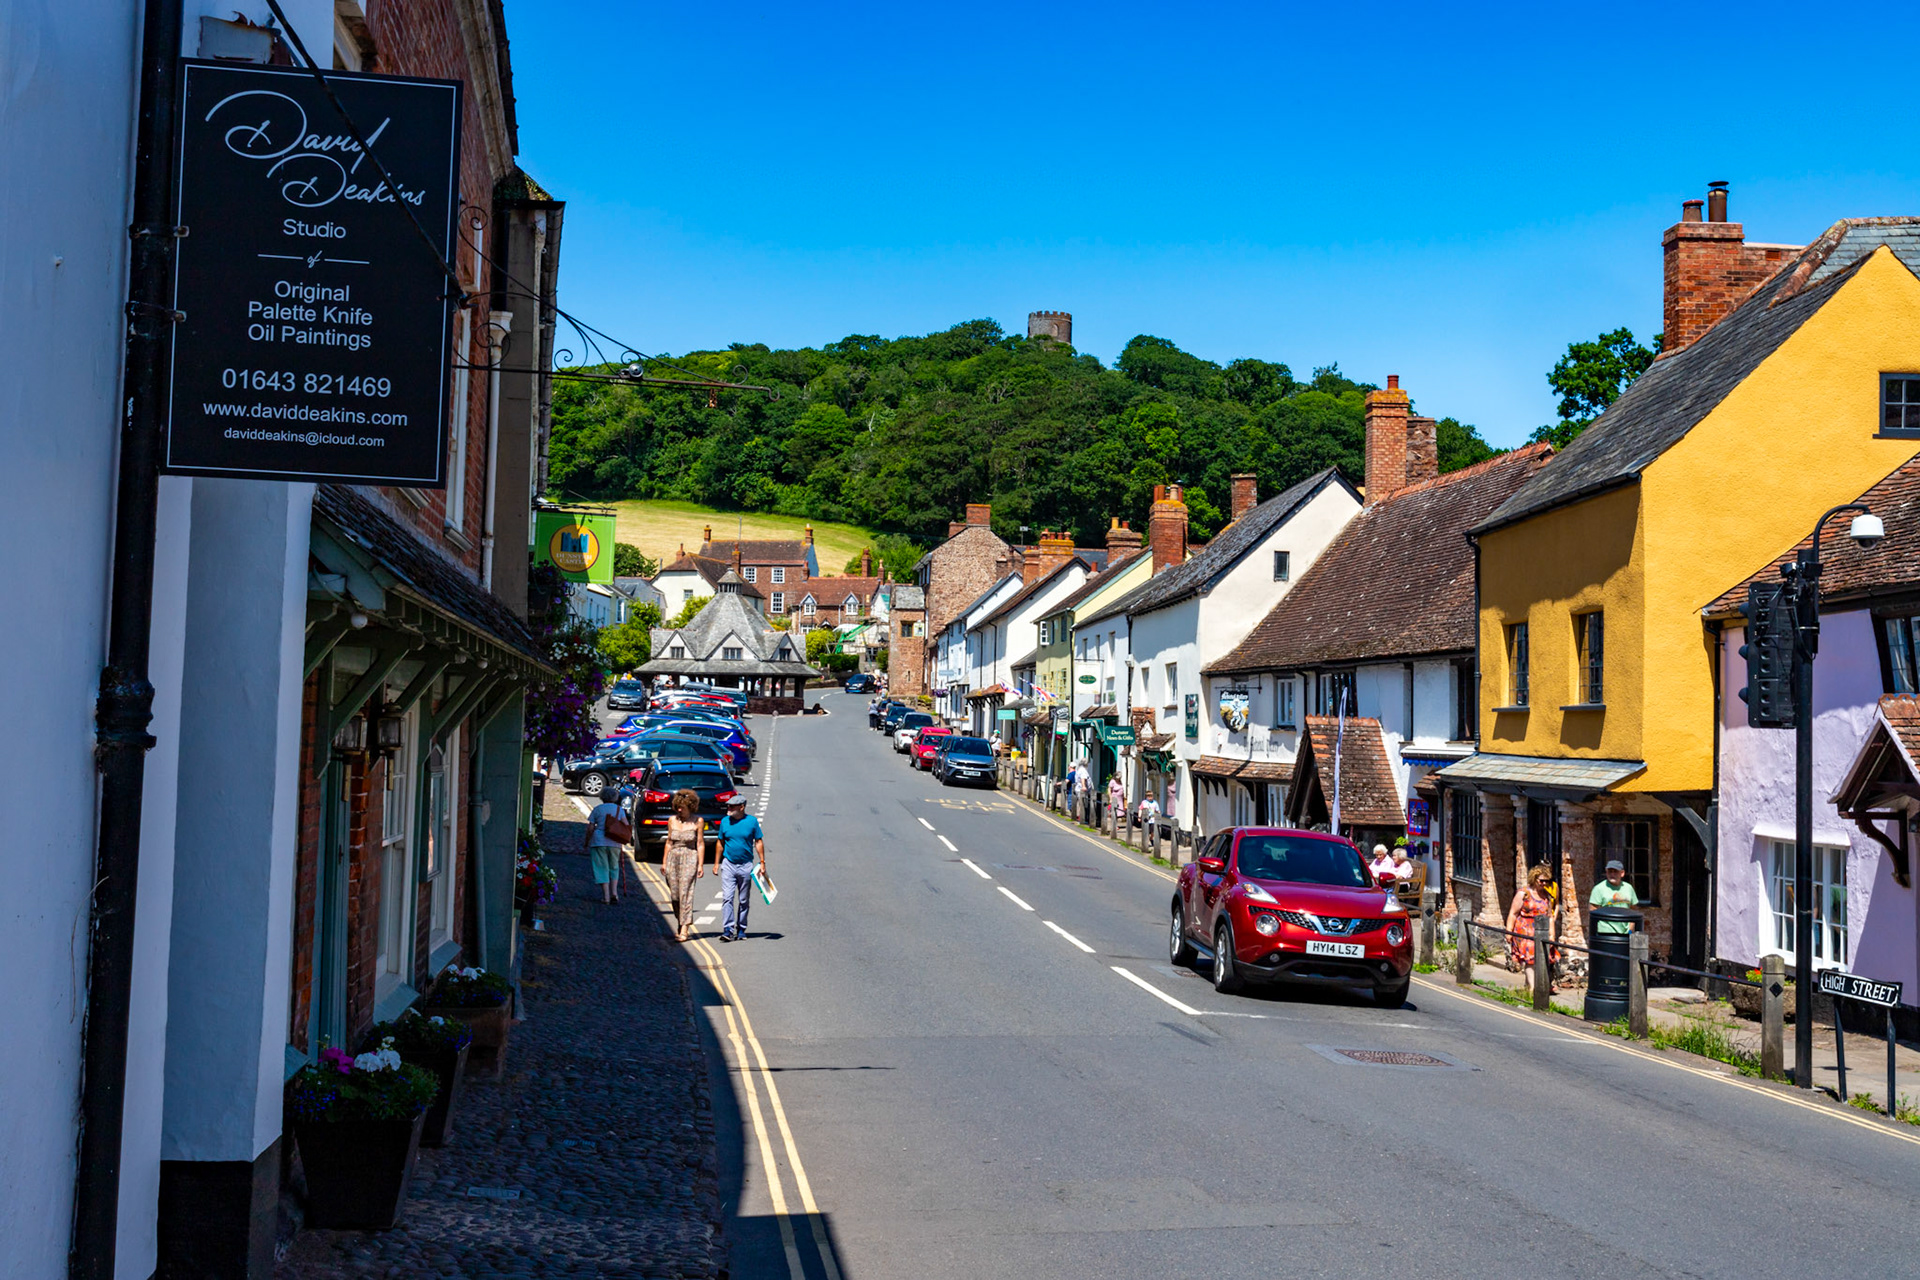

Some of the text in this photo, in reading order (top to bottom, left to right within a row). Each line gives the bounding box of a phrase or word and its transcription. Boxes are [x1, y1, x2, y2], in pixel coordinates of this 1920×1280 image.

[267, 153, 425, 207] Deakins
[283, 218, 347, 239] Studio
[307, 250, 323, 268] of
[274, 280, 350, 303] Original
[248, 301, 373, 325] Palette Knife
[248, 323, 372, 351] Oil Paintings
[222, 368, 391, 398] 01643 821469
[203, 401, 408, 427] www.daviddeakins.com
[224, 427, 385, 447] daviddeakins@icloud.com
[1312, 942, 1359, 955] HY14 LSZ
[1824, 974, 1895, 1001] HIGH STREET
